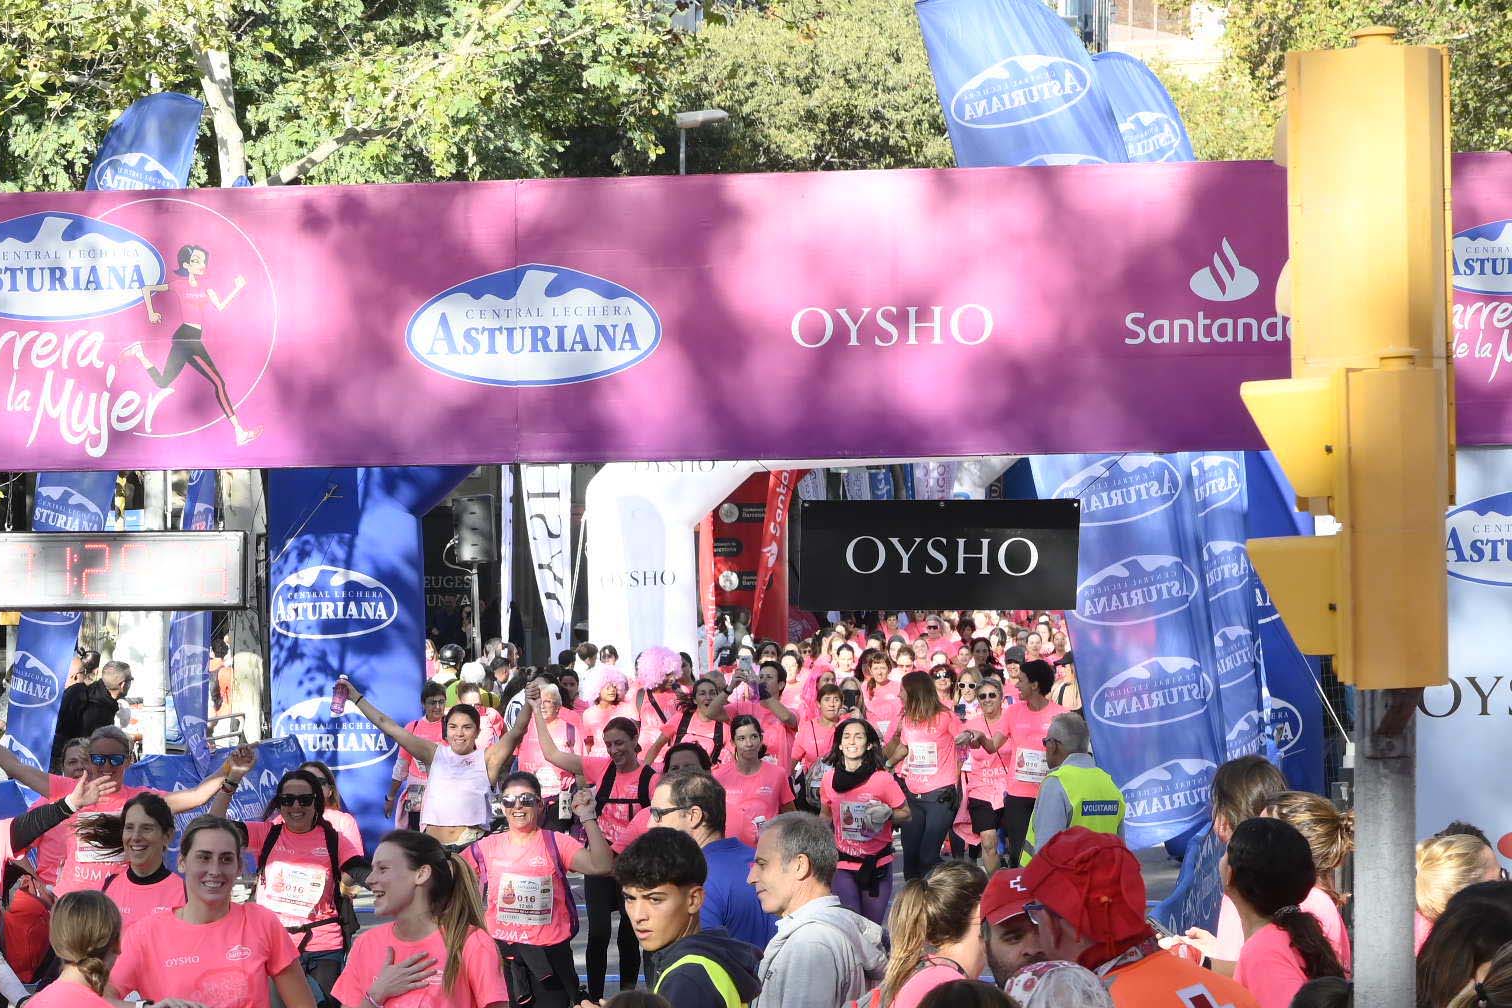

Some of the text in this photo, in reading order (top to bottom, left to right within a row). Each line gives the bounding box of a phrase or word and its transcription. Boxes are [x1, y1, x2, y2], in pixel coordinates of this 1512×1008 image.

[465, 306, 632, 320] CENTRAL LECHERA
[1453, 301, 1512, 330] arre
[426, 312, 641, 356] ASTURIANA
[789, 303, 995, 349] OYSHO
[1123, 310, 1292, 347] Santand
[1475, 328, 1492, 359] la
[6, 371, 31, 412] la
[26, 363, 175, 458] Mujer
[770, 471, 789, 536] Santa
[34, 508, 98, 530] STURIANA
[1472, 523, 1512, 534] CENT
[845, 535, 1038, 576] OYSHO
[424, 576, 472, 588] EUGES
[275, 595, 388, 624] ASTURIANA
[336, 722, 379, 730] LECHER
[297, 732, 388, 752] TURIANA
[517, 895, 536, 903] 016
[493, 929, 528, 940] SUMA
[166, 955, 199, 967] OYSHO
